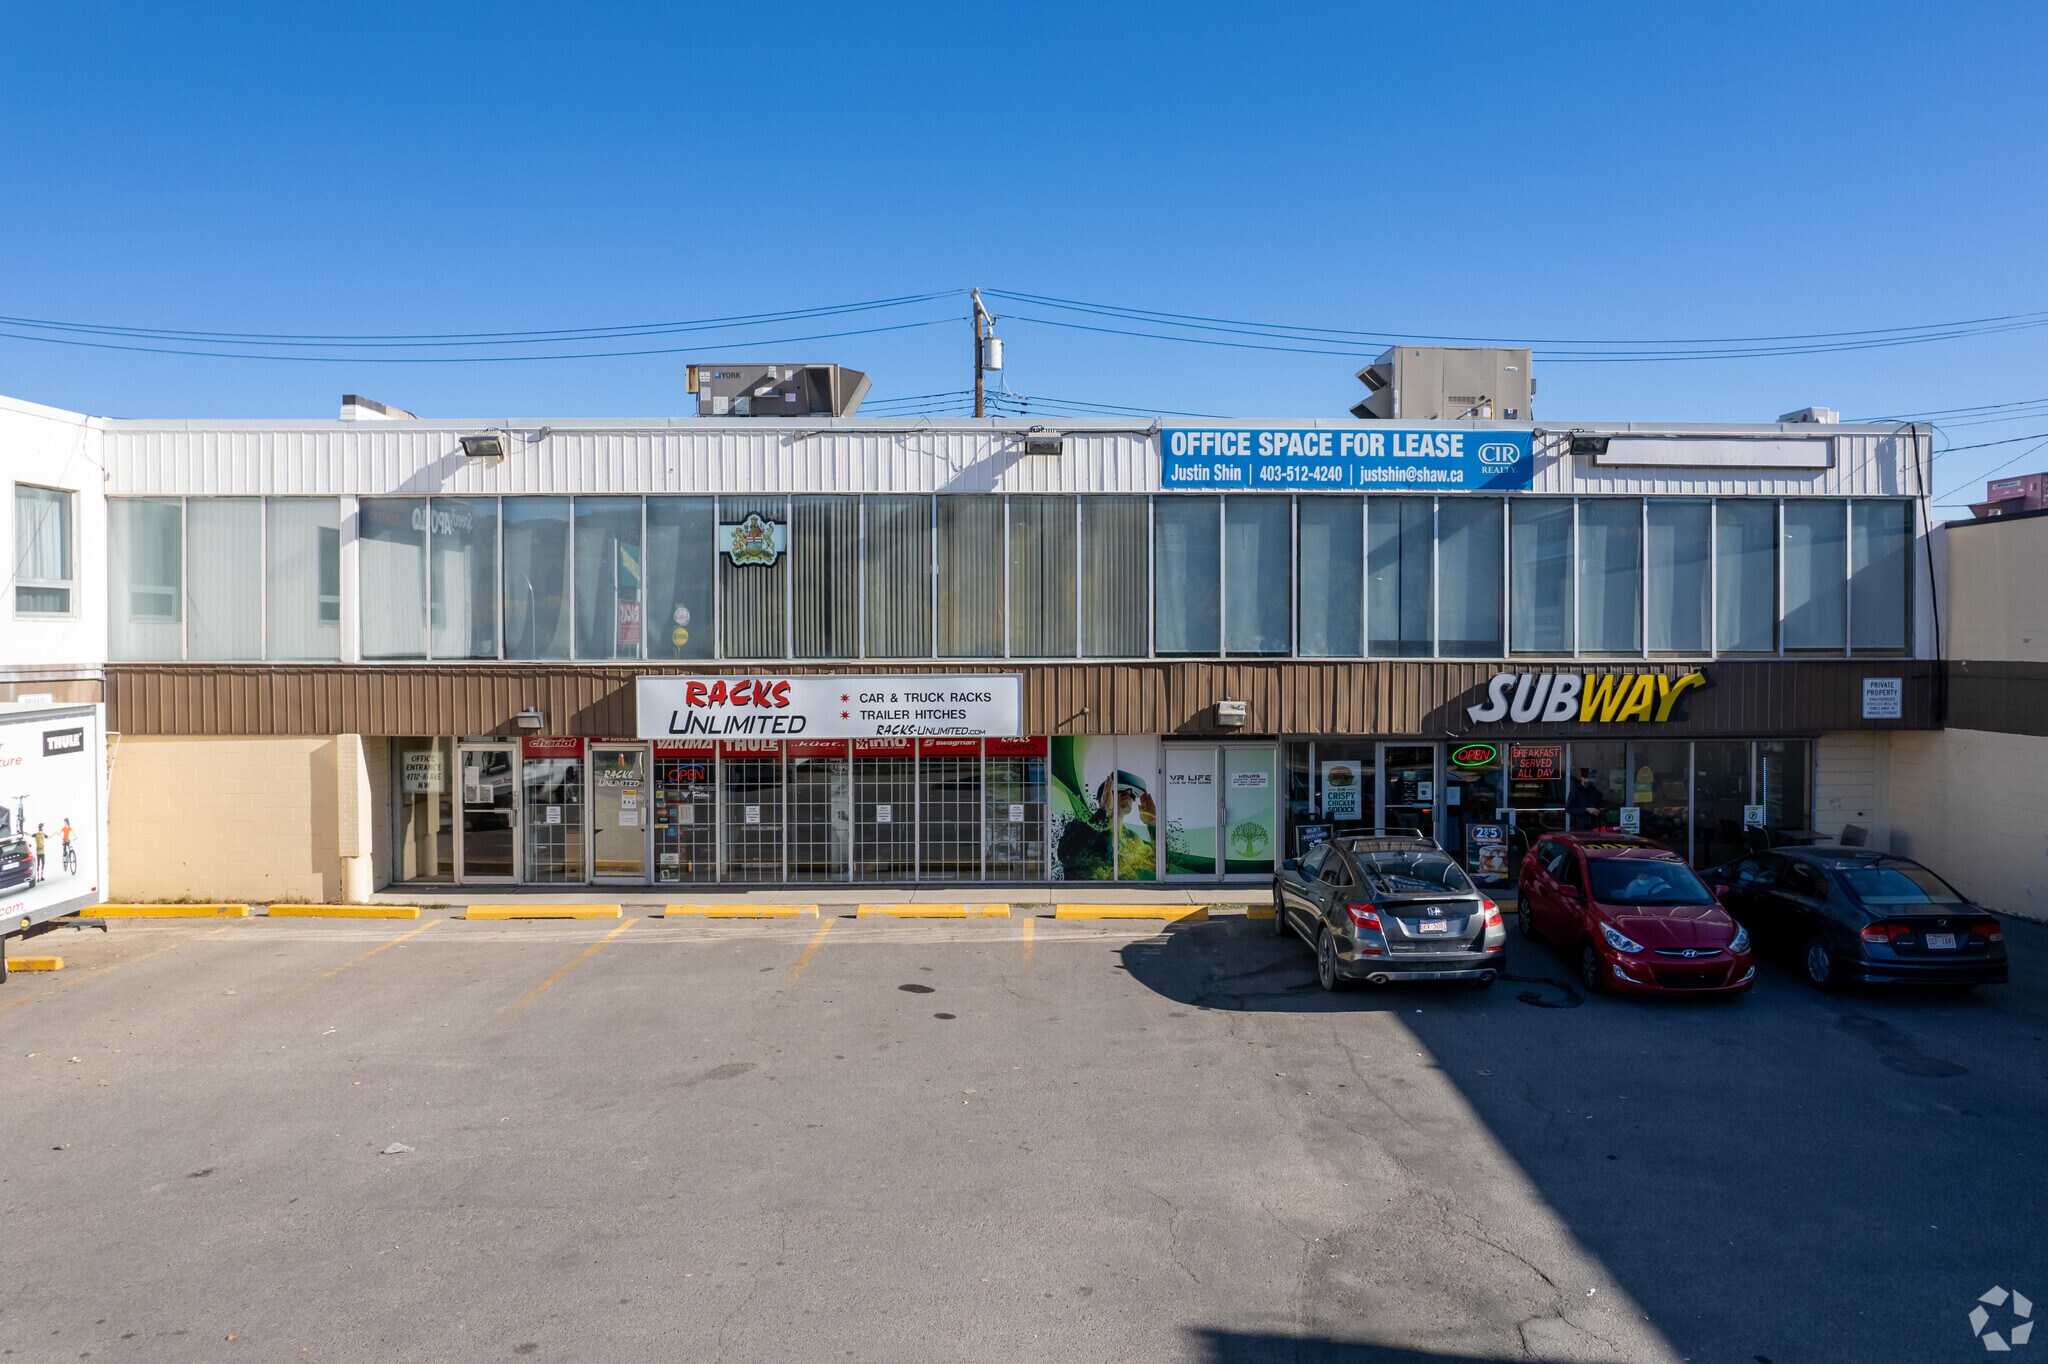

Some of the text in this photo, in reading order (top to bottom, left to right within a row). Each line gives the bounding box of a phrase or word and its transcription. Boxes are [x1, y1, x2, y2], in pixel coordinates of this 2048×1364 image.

[1170, 431, 1464, 457] OFFICE SPACE FOR LEASE
[1481, 445, 1514, 463] CIR
[1171, 463, 1464, 485] Justin Shin 403-512-4240 justshin@shaw.ca
[1481, 466, 1518, 474] REALTY
[685, 679, 791, 709] RACKS
[859, 692, 992, 703] CAR & TRUCK RACKS
[1466, 670, 1707, 726] SUBWAY
[859, 709, 967, 720] TRAILER HITCHES
[668, 710, 807, 735] UNLIMITED
[46, 733, 80, 750] THULE
[529, 738, 578, 748] chariot
[656, 739, 714, 749] YAKIMA
[723, 739, 779, 751] THULE
[935, 740, 977, 748] swagman
[411, 754, 436, 762] OFFICE
[1457, 749, 1491, 761] OPEN
[1513, 748, 1560, 758] BREAKFAST
[406, 763, 442, 771] ENTRANCE
[1519, 758, 1553, 768] SERVED
[603, 770, 634, 779] RACKS
[668, 769, 705, 781] OPEN
[1517, 768, 1555, 778] ALL DAY
[1327, 791, 1355, 800] CRISPY
[1476, 827, 1484, 838] 2
